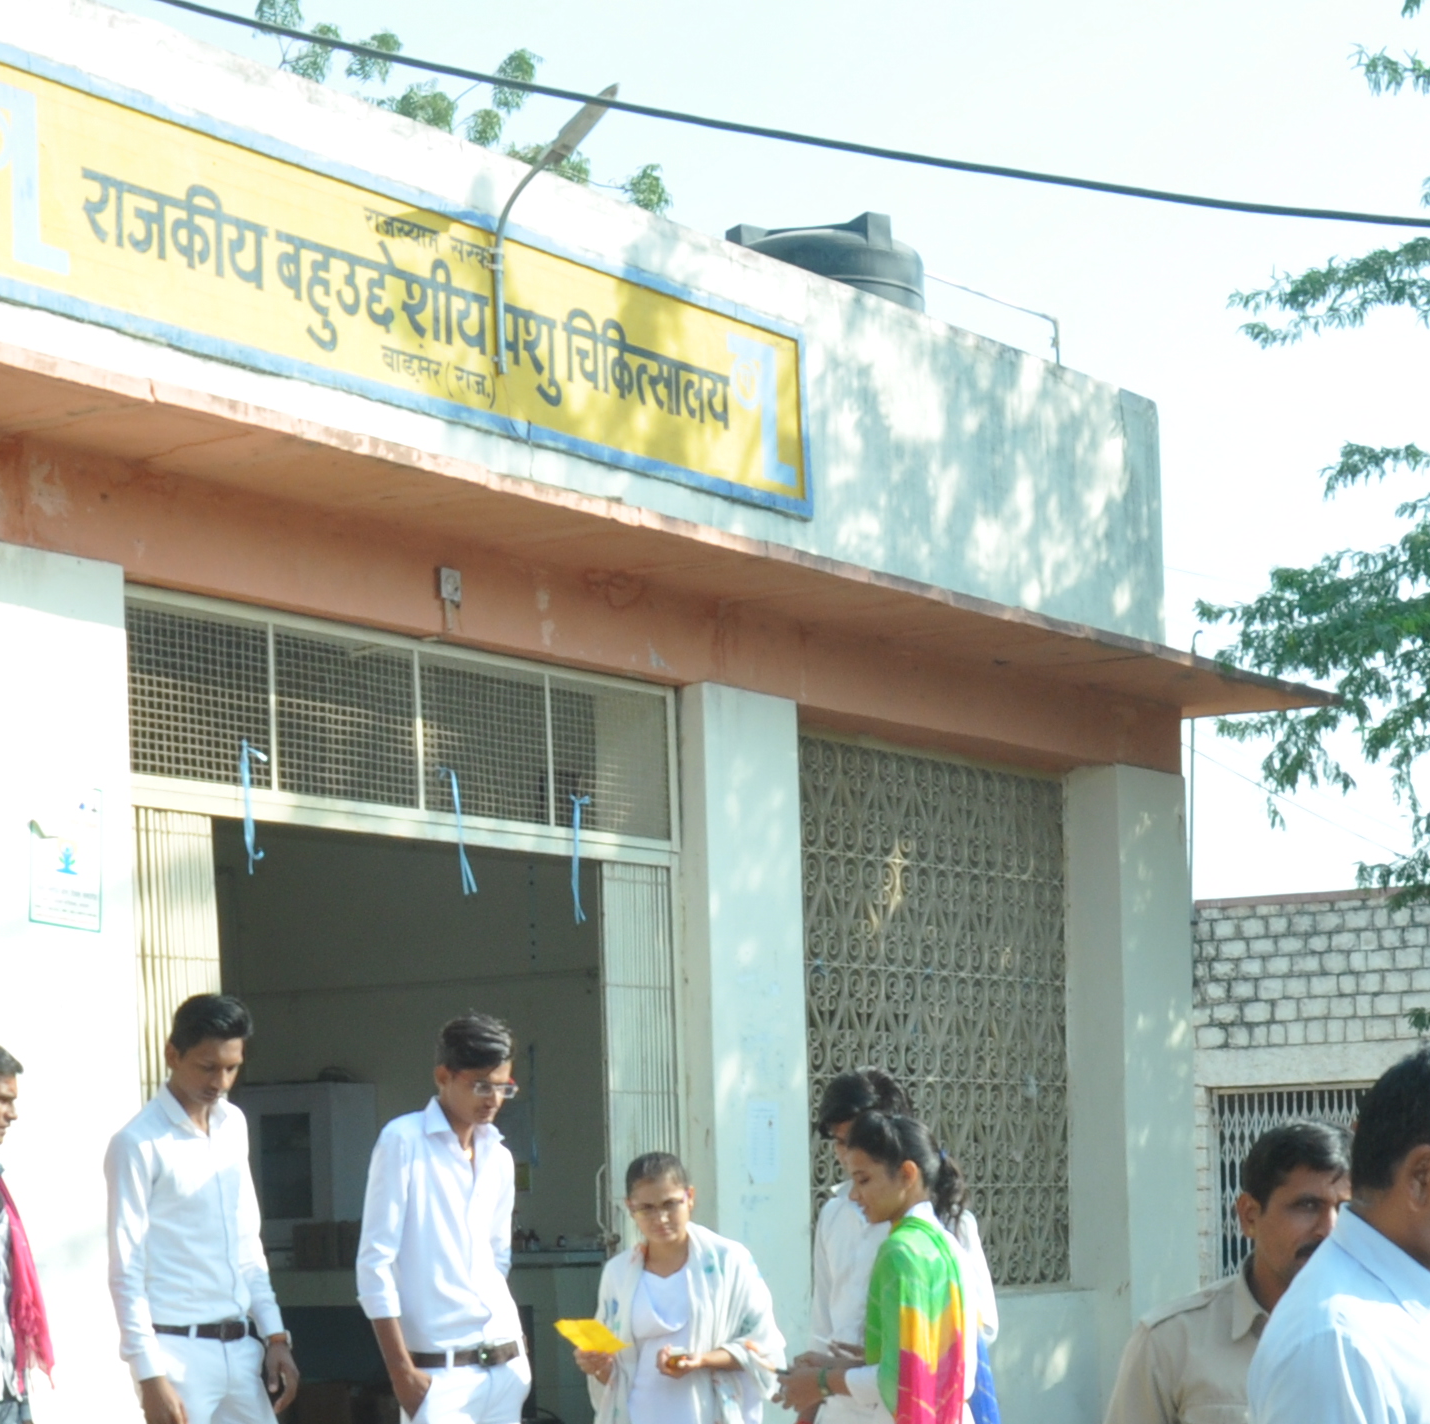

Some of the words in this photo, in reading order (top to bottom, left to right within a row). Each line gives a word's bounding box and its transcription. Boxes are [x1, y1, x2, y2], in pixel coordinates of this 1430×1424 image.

[80, 166, 268, 290] राजकीय
[275, 228, 489, 356] बहुउद्देशीय
[502, 302, 562, 407] पशु
[562, 308, 730, 430] चिकित्सालय
